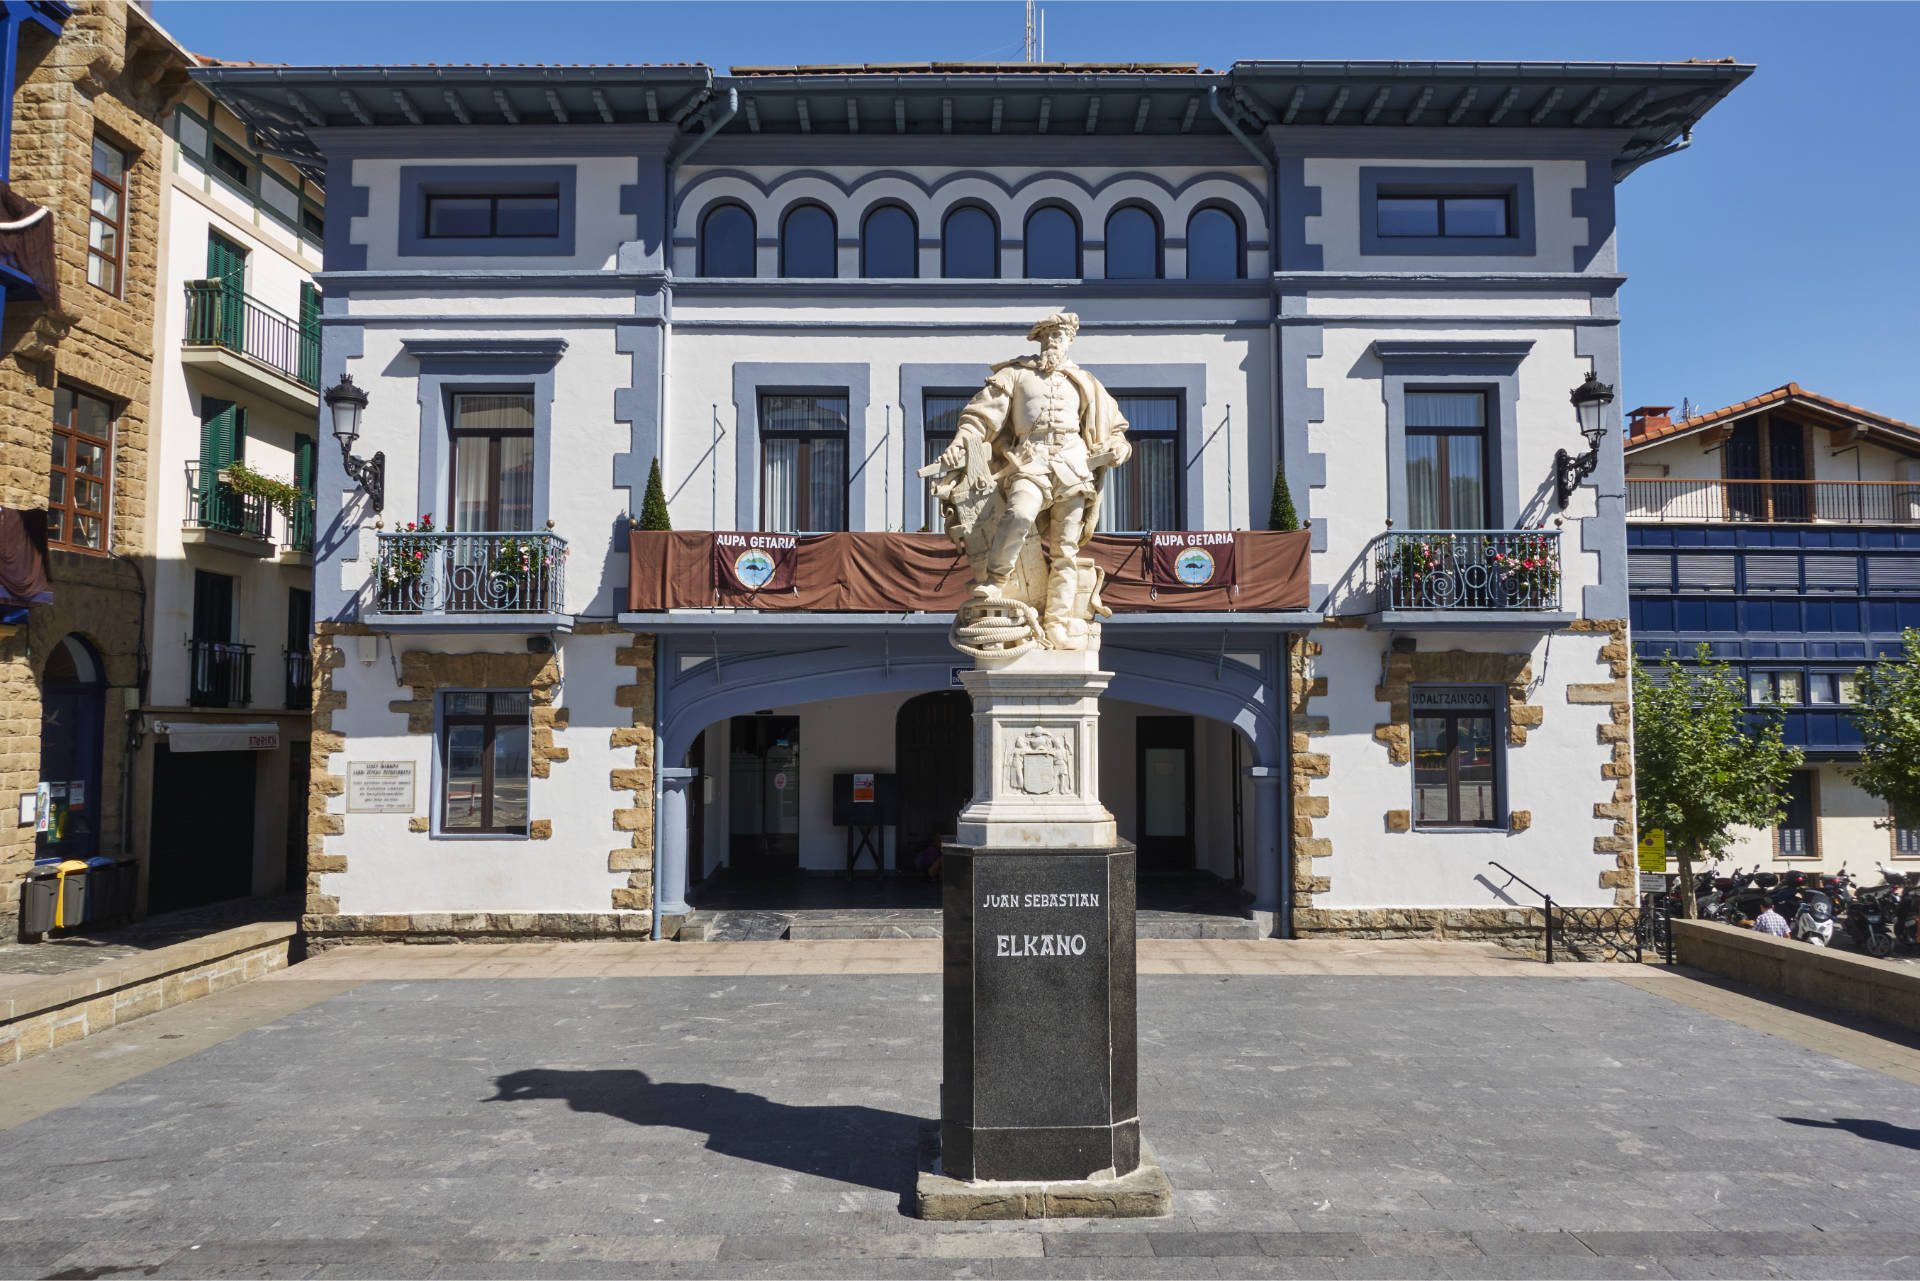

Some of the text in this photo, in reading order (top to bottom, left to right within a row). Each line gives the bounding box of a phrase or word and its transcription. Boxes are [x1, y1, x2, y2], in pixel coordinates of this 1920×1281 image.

[717, 535, 796, 549] AUPA GETARIA
[1155, 533, 1234, 546] AUPA GETARIA
[1413, 693, 1489, 705] UDALTZAINGOA
[983, 893, 1099, 908] JUAN SEBASTIAN
[996, 934, 1087, 957] ELKANO
